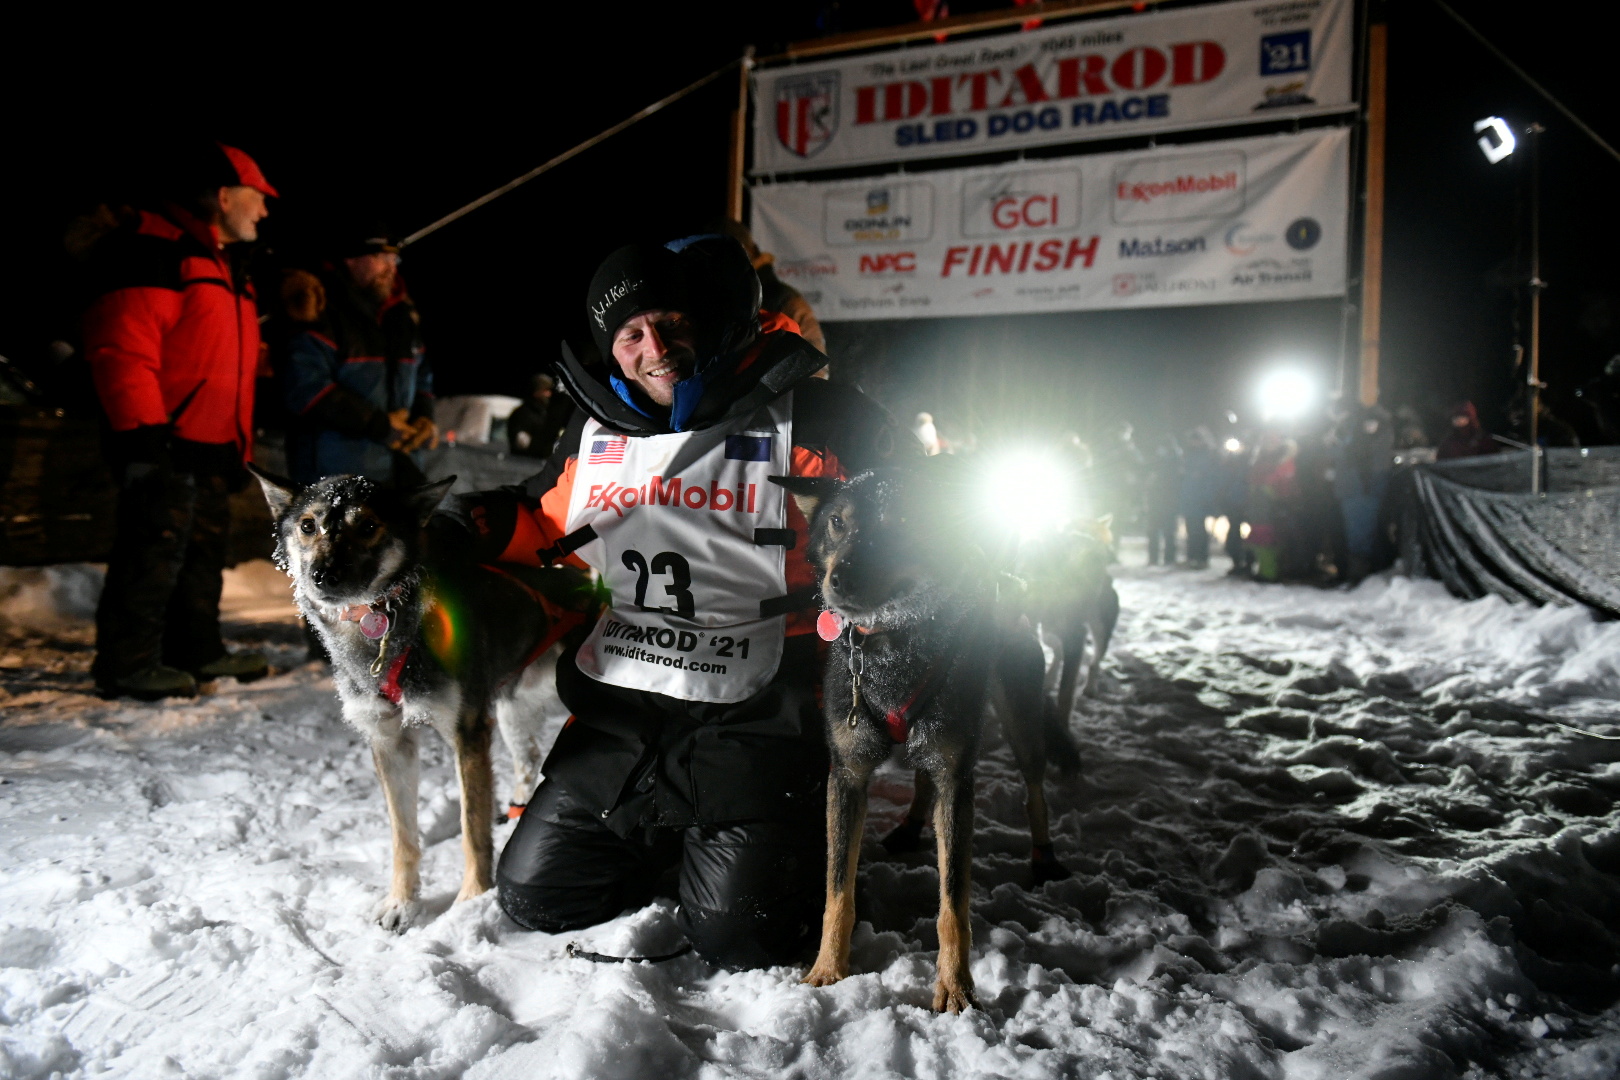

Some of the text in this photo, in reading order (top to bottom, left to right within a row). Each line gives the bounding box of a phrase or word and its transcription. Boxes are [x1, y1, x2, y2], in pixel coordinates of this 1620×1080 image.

[853, 41, 1227, 126] IDITAROD
[896, 94, 1171, 147] SLED DOG RACE
[991, 193, 1059, 230] GCI
[859, 251, 917, 273] NAC
[941, 234, 1102, 278] FINISH
[1118, 236, 1207, 259] Matson
[621, 549, 696, 619] 23
[603, 643, 727, 675] www.iditarod.com
[709, 636, 750, 660] '21
